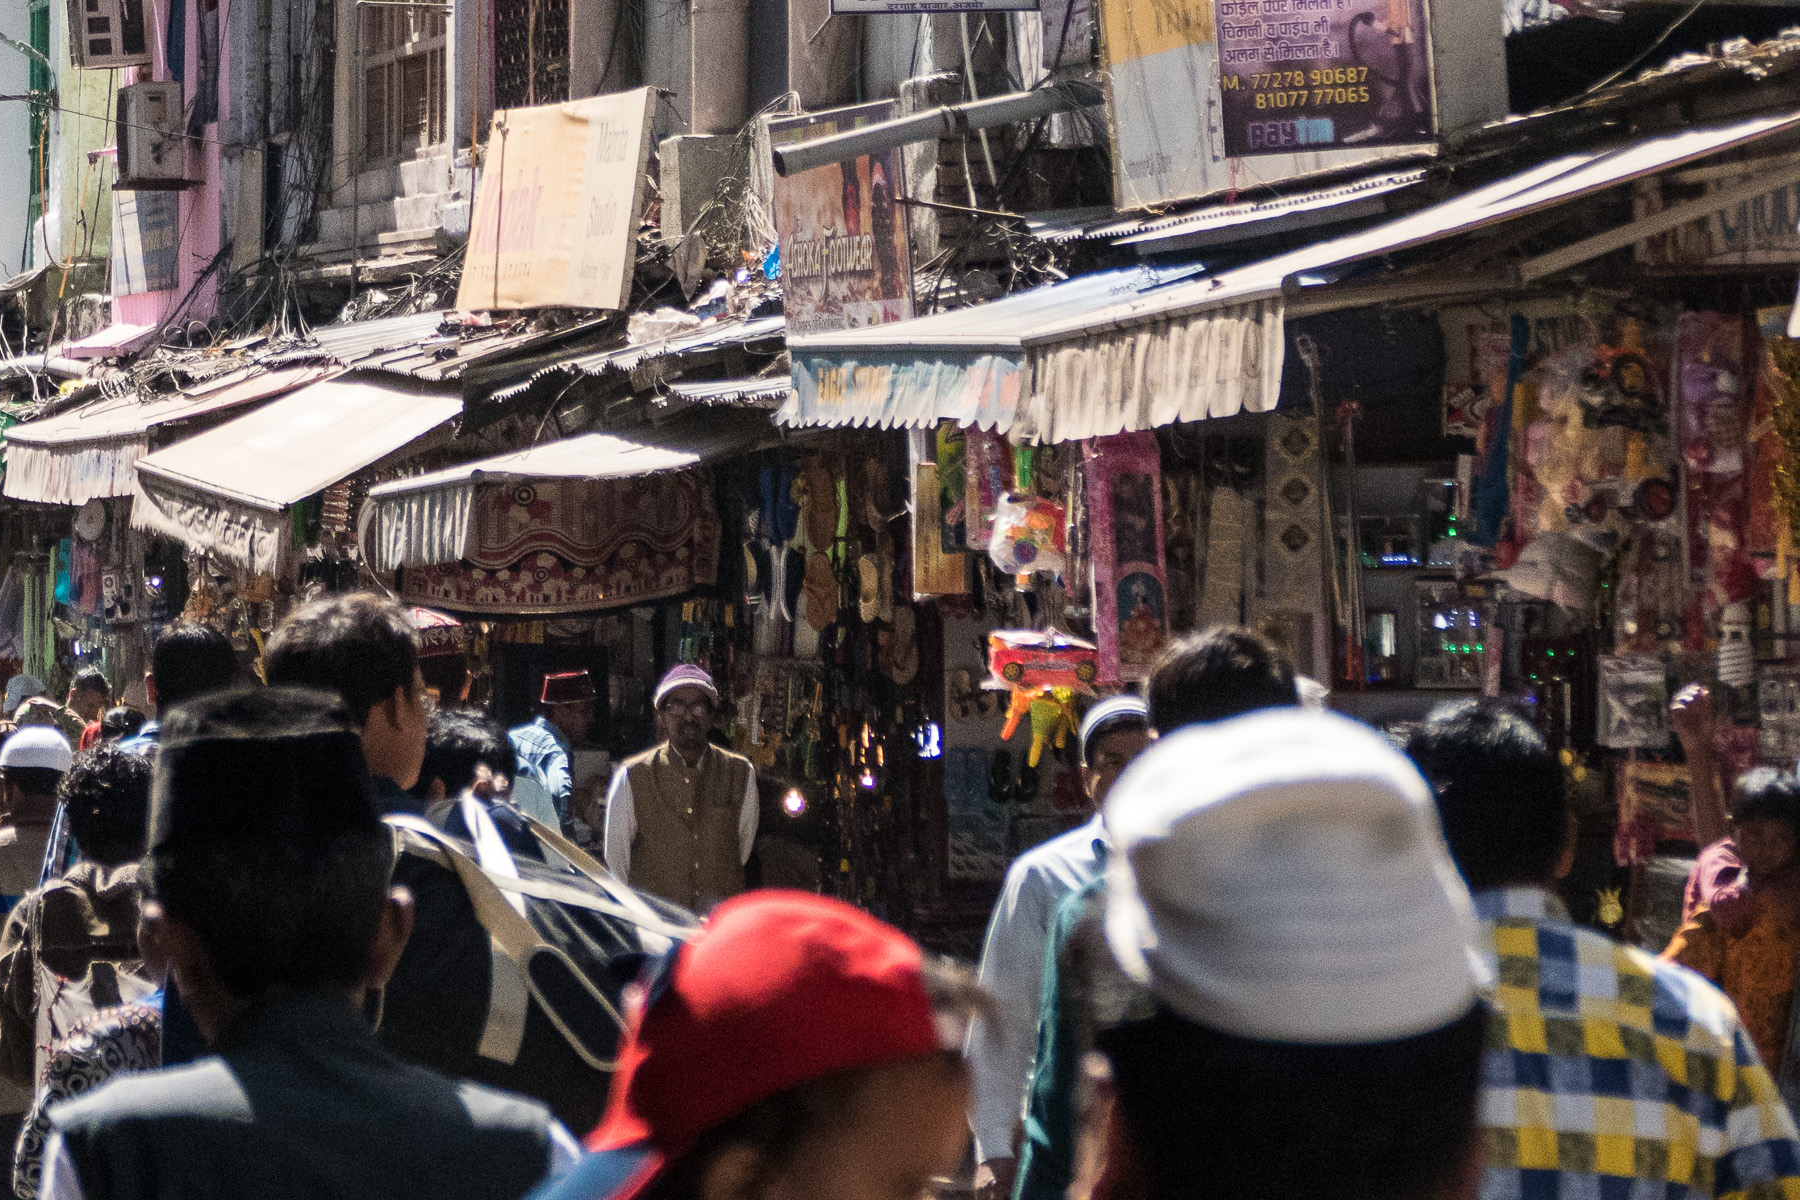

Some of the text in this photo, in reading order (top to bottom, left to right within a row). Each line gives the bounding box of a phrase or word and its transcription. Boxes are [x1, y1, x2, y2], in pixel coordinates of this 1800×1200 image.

[1313, 16, 1331, 34] भी
[1278, 41, 1319, 60] मिलता
[1251, 71, 1305, 90] 77278
[1309, 66, 1368, 86] 90687
[1255, 86, 1370, 109] 81077 77065
